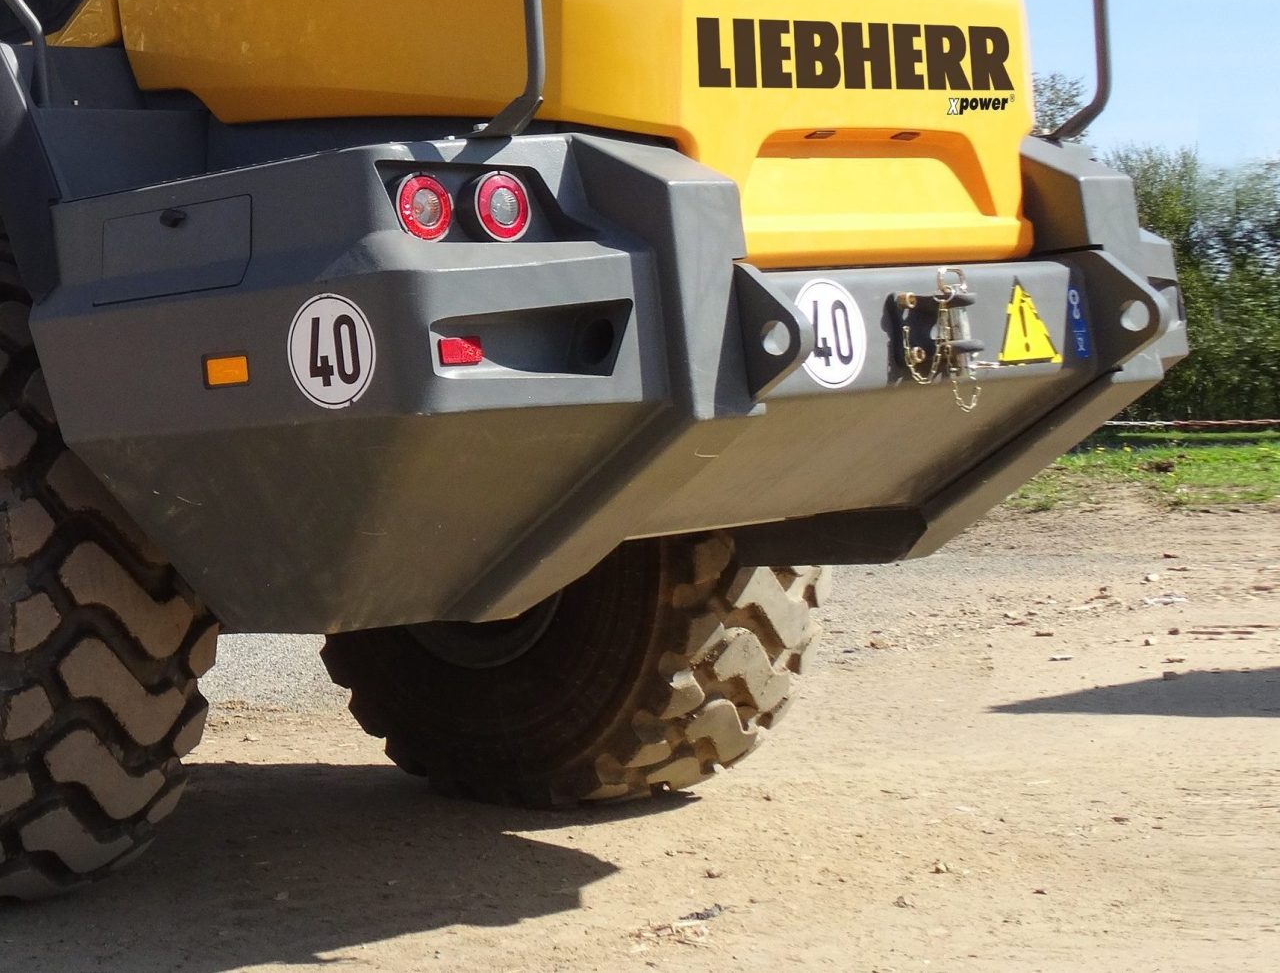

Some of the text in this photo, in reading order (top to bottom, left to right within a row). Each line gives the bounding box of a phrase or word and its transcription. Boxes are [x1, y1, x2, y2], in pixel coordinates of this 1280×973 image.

[696, 17, 1014, 90] LIEBHERR
[310, 314, 361, 387] 40
[812, 299, 853, 367] 40
